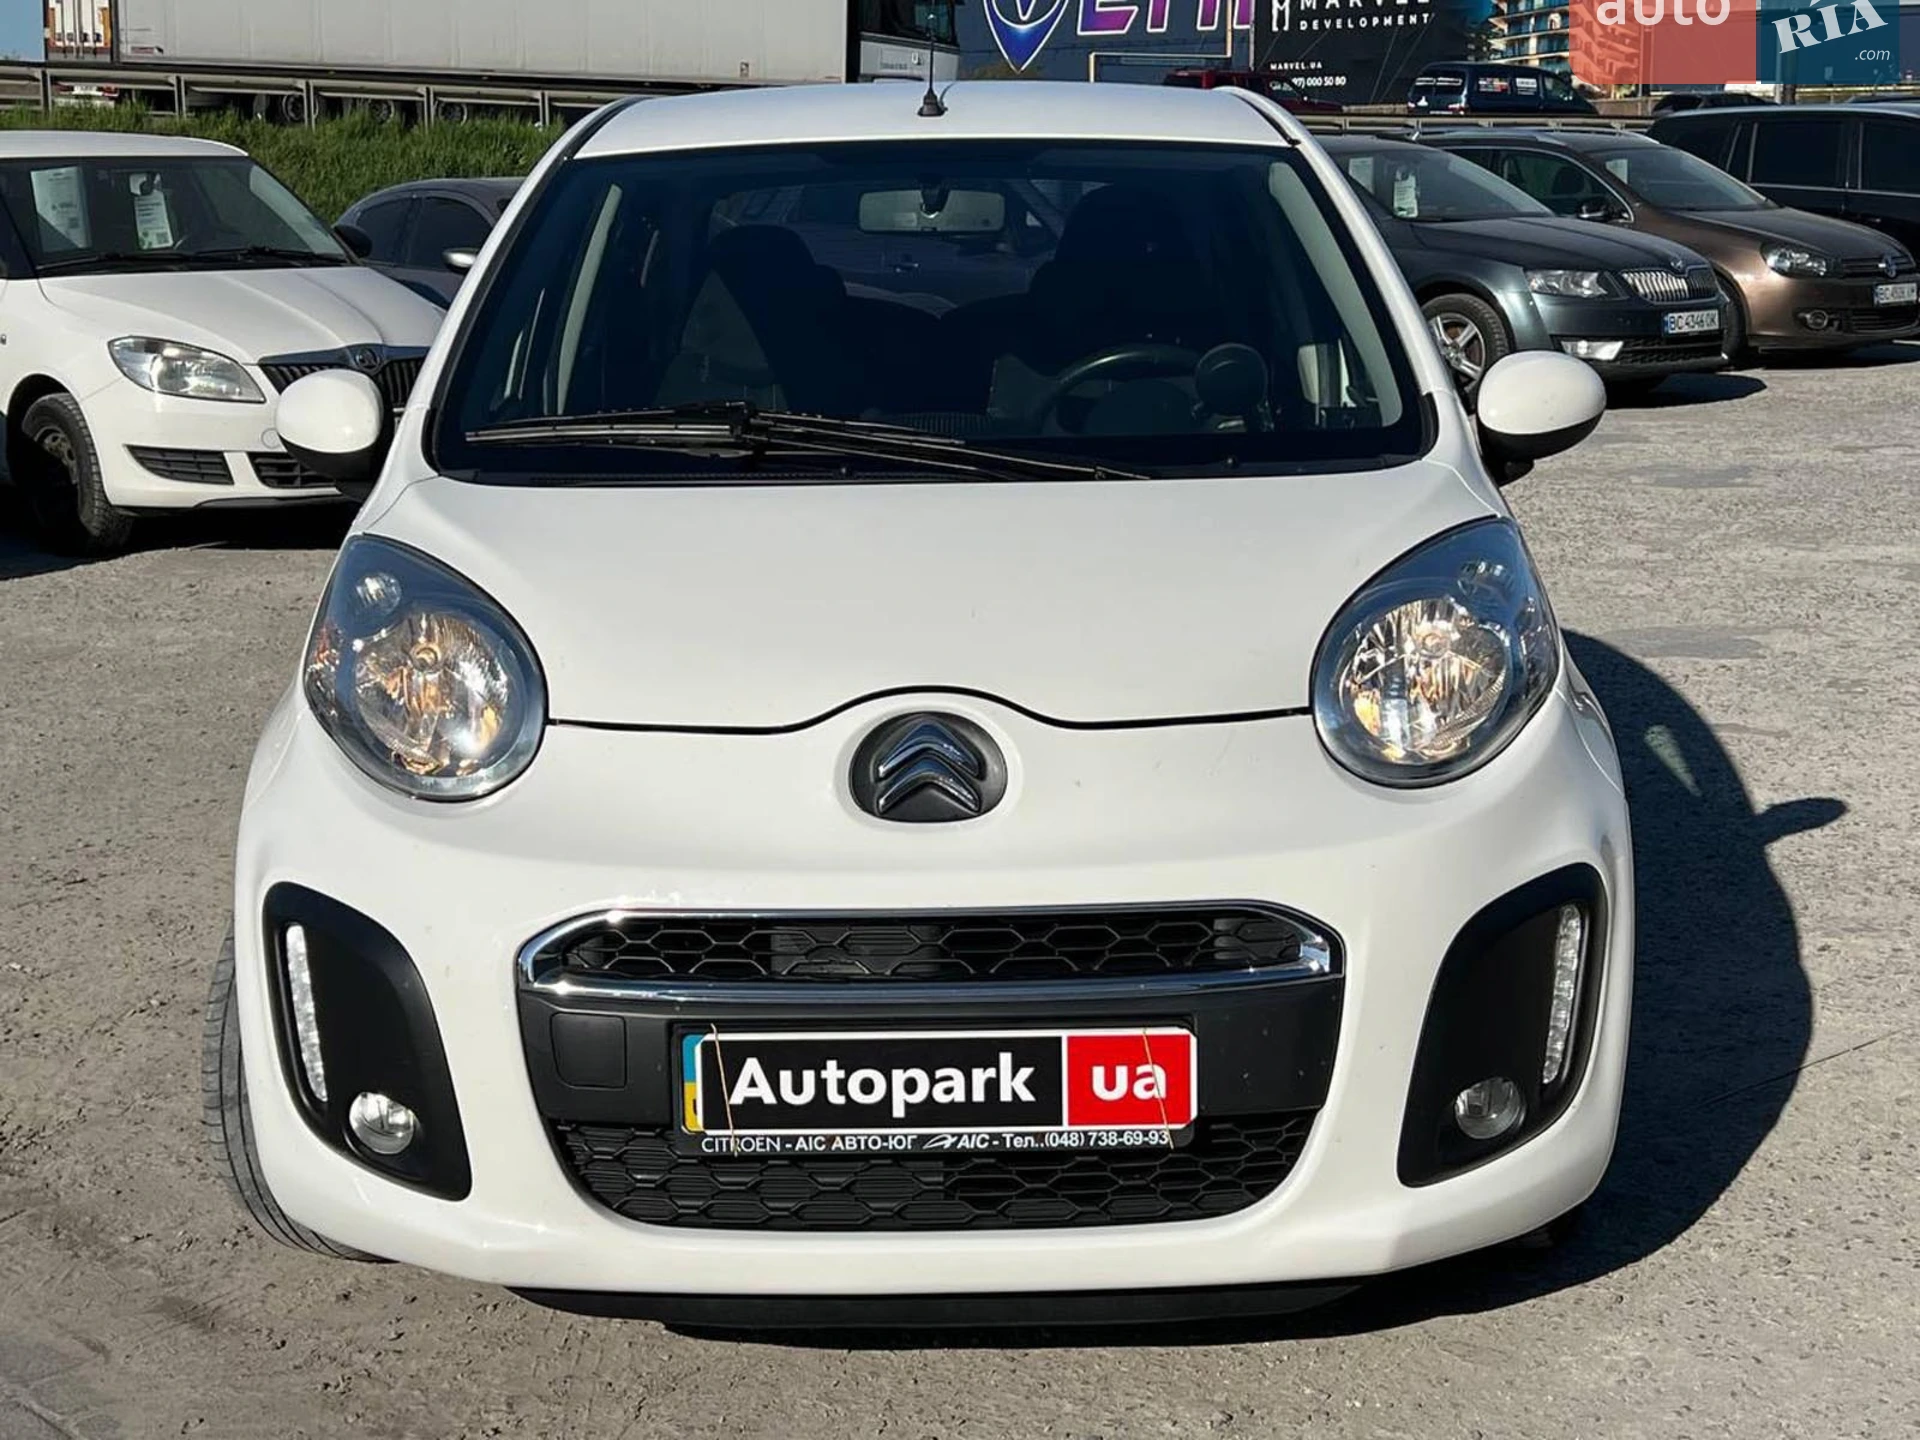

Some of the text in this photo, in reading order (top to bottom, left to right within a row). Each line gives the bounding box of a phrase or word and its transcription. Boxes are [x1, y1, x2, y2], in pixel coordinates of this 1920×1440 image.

[1300, 14, 1430, 30] DEVELOPMENT
[728, 1052, 1168, 1118] Autopark ua
[1088, 1130, 1168, 1147] 738-69-93
